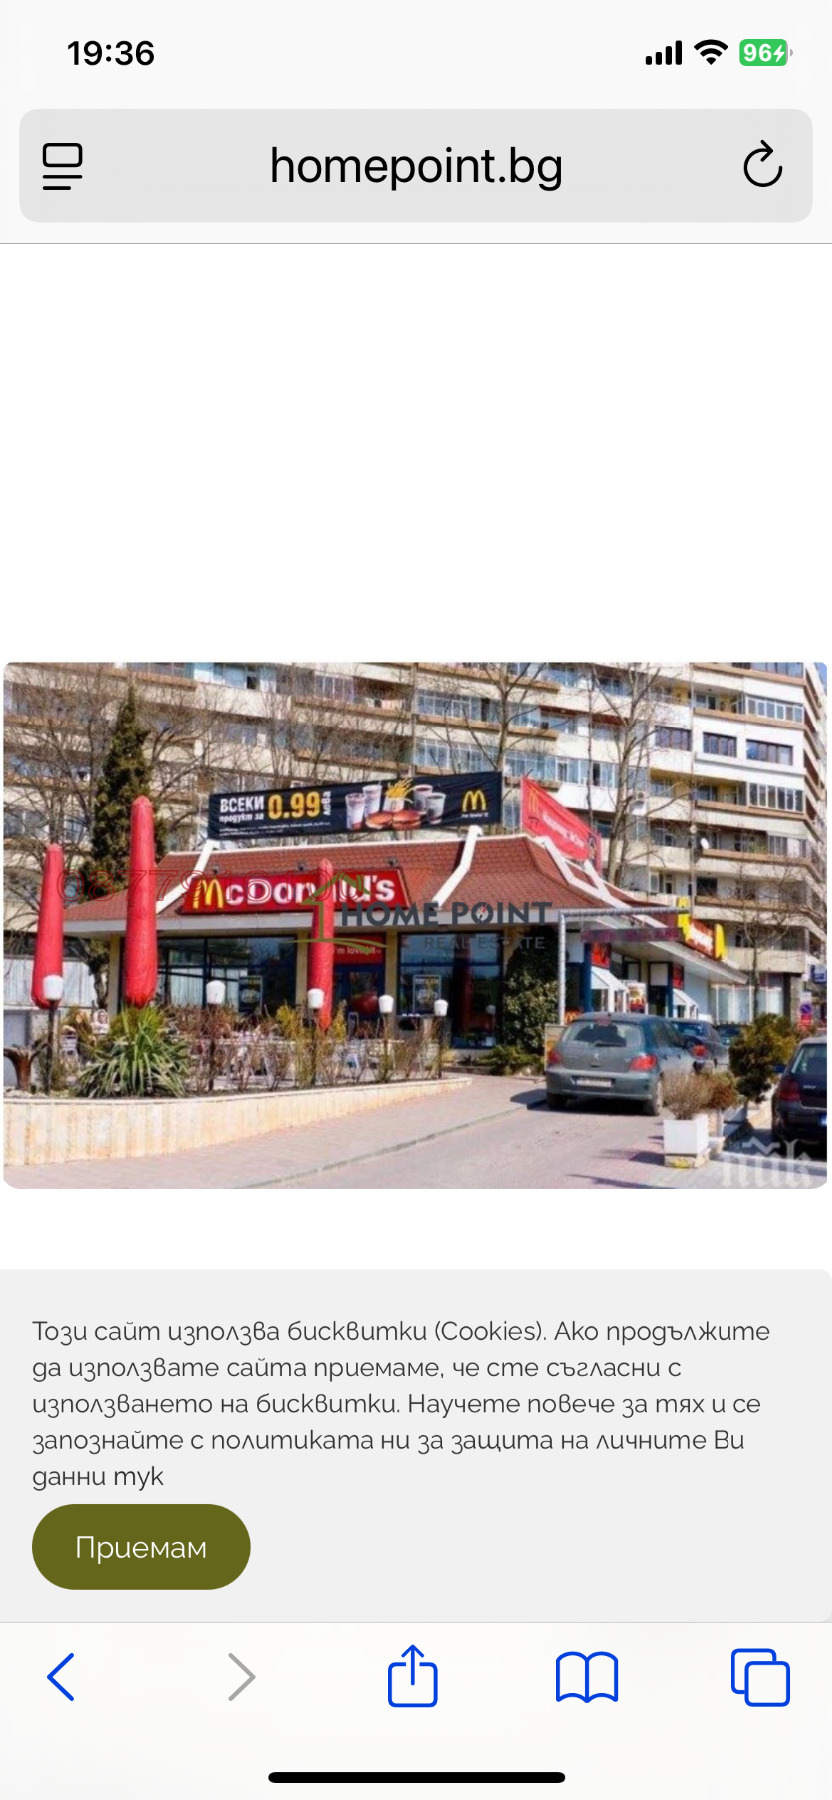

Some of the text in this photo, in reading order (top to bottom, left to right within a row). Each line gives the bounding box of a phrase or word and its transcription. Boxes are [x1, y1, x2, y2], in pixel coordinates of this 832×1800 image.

[68, 40, 154, 66] 19:36
[744, 43, 772, 62] 96
[272, 146, 561, 191] homepoint.bg
[220, 795, 265, 813] ВСЕКИ
[268, 791, 320, 820] 0.99
[321, 791, 331, 816] лева
[219, 812, 252, 824] продукт
[32, 1321, 770, 1346] Този сайт използва бисквитки (Cookies). Ако продължите
[33, 1357, 681, 1382] да използвате сайта приемаме, че сте съгласни с
[33, 1393, 760, 1418] използването на бисквитки. Научете повече за тях и се
[33, 1429, 744, 1454] запознайте с политиката ни за защита на личните Ви
[33, 1466, 164, 1491] данни тук
[77, 1536, 206, 1564] Приемам
